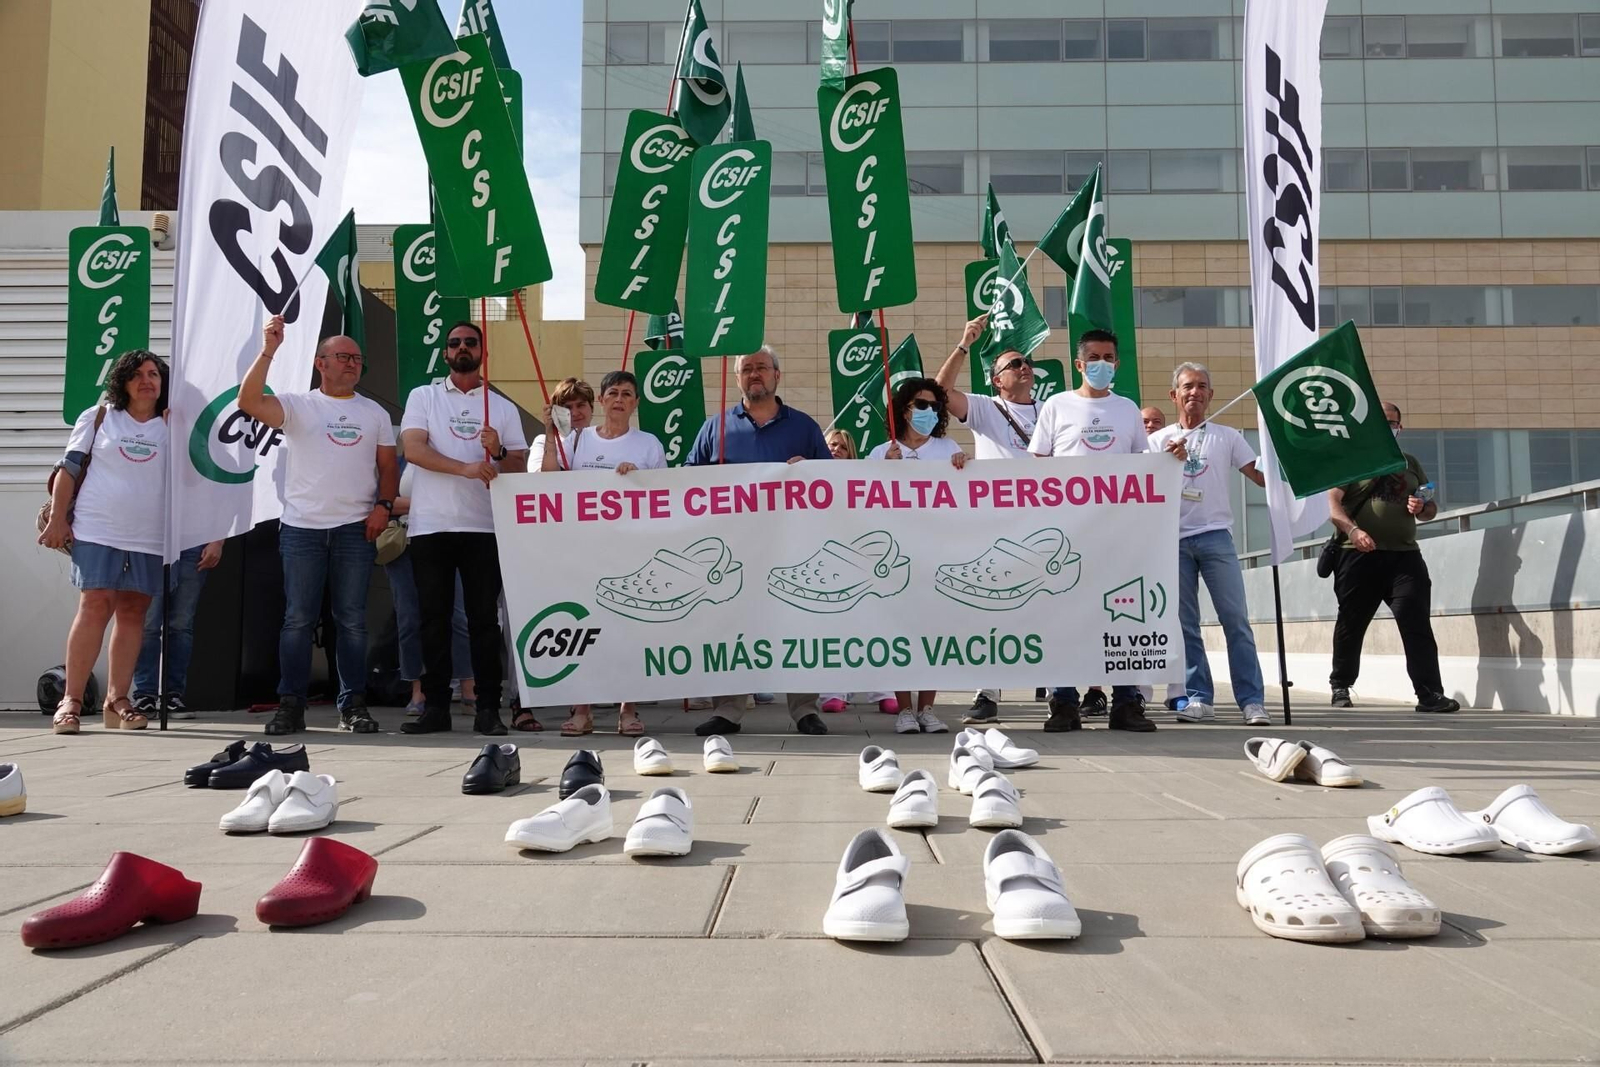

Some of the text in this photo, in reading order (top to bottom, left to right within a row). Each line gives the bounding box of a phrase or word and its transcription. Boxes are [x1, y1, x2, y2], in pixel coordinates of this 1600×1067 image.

[433, 67, 484, 104] CSIF
[841, 98, 890, 131] CSIF
[643, 137, 694, 162] CSIF
[209, 13, 328, 324] CSIF
[710, 165, 762, 189] CSIF
[1263, 43, 1315, 332] CSIF
[90, 250, 140, 271] CSIF
[845, 345, 882, 362] CSIF
[653, 369, 694, 388] CSIF
[1029, 382, 1057, 400] SIF
[1299, 380, 1350, 439] CSIF
[515, 473, 1166, 524] EN ESTE CENTRO FALTA PERSONAL
[529, 627, 602, 659] CSIF
[1103, 631, 1168, 647] tu voto
[644, 627, 1044, 677] NO MÁS ZUECOS VACÍOS
[1104, 649, 1127, 657] tiene
[1141, 648, 1167, 657] última
[1105, 657, 1167, 674] palabra
